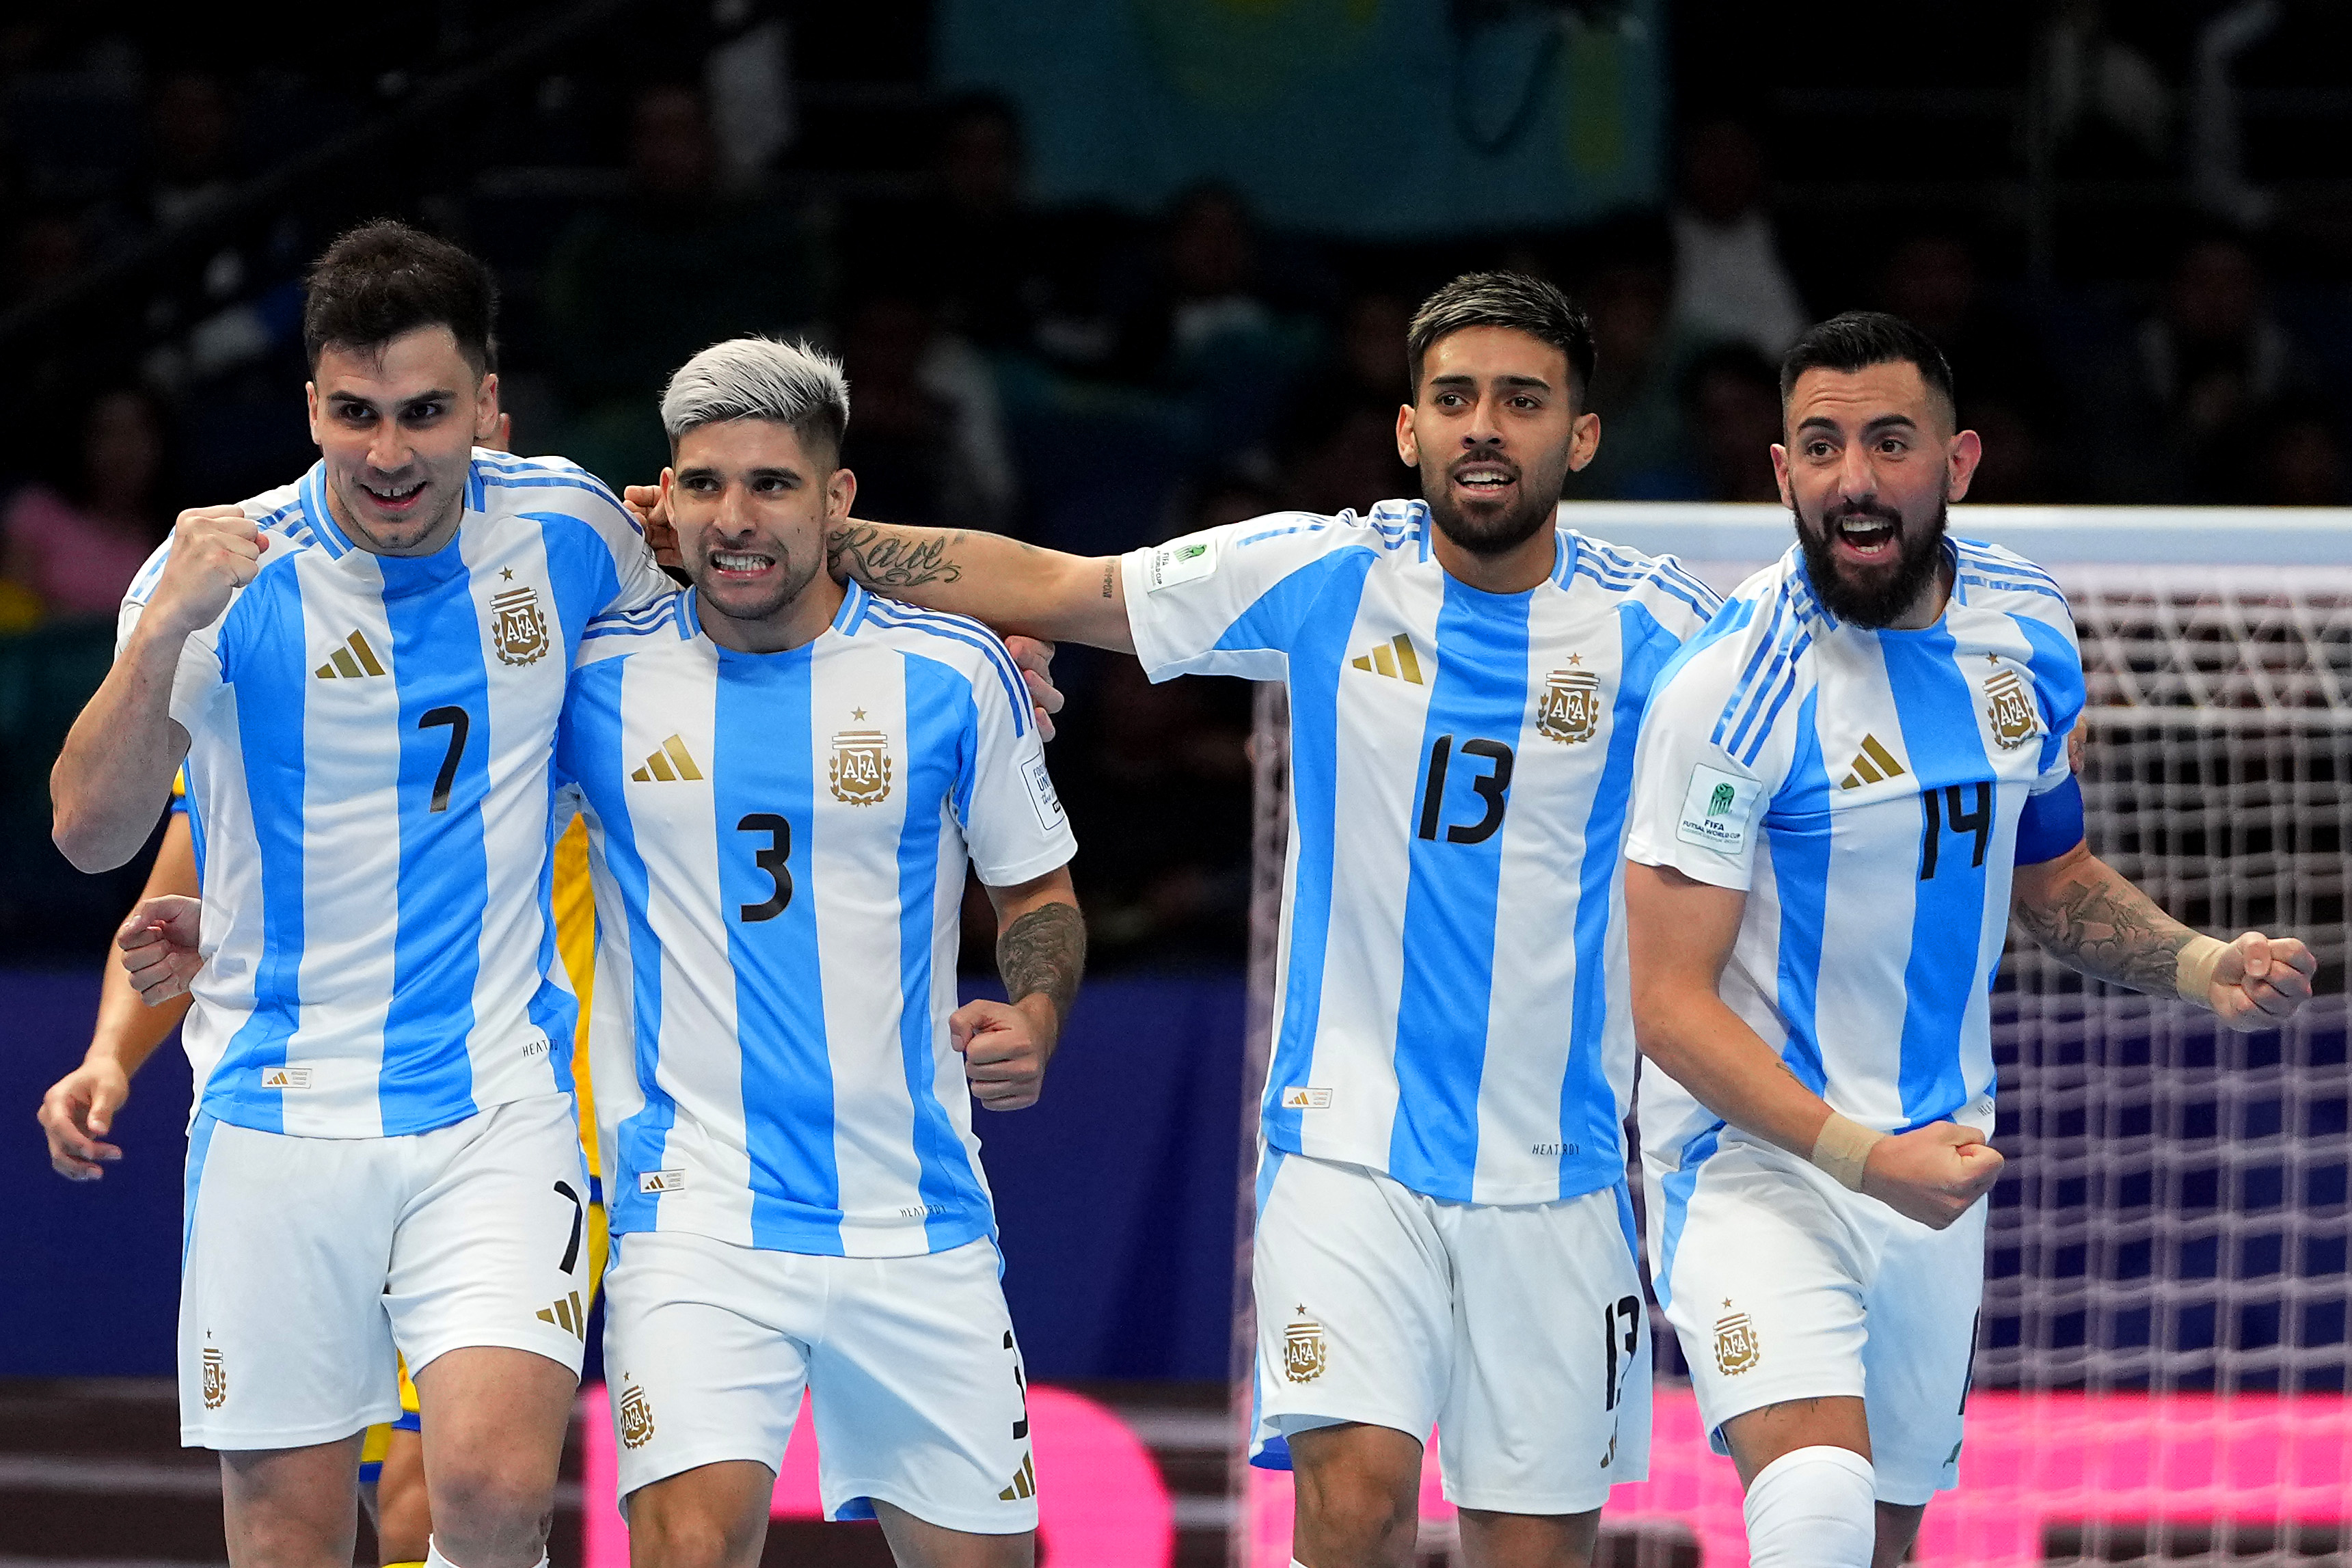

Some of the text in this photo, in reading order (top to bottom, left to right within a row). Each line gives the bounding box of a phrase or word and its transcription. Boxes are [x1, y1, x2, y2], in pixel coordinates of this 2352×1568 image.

[1161, 552, 1170, 567] FIFA
[506, 608, 538, 644] AFA
[1550, 688, 1586, 725] AFA
[1998, 691, 2027, 727] AFA
[418, 705, 469, 813] 7
[842, 749, 879, 785] AFA
[1418, 734, 1514, 845] 13
[1682, 820, 1705, 833] FUTSAL
[1705, 828, 1729, 839] WORLD
[1704, 819, 1725, 831] FIFA
[1921, 781, 1991, 880] 14
[737, 813, 793, 923] 3
[554, 1180, 583, 1275] 7
[1290, 1338, 1316, 1366] AFA
[1722, 1329, 1748, 1358] AFA
